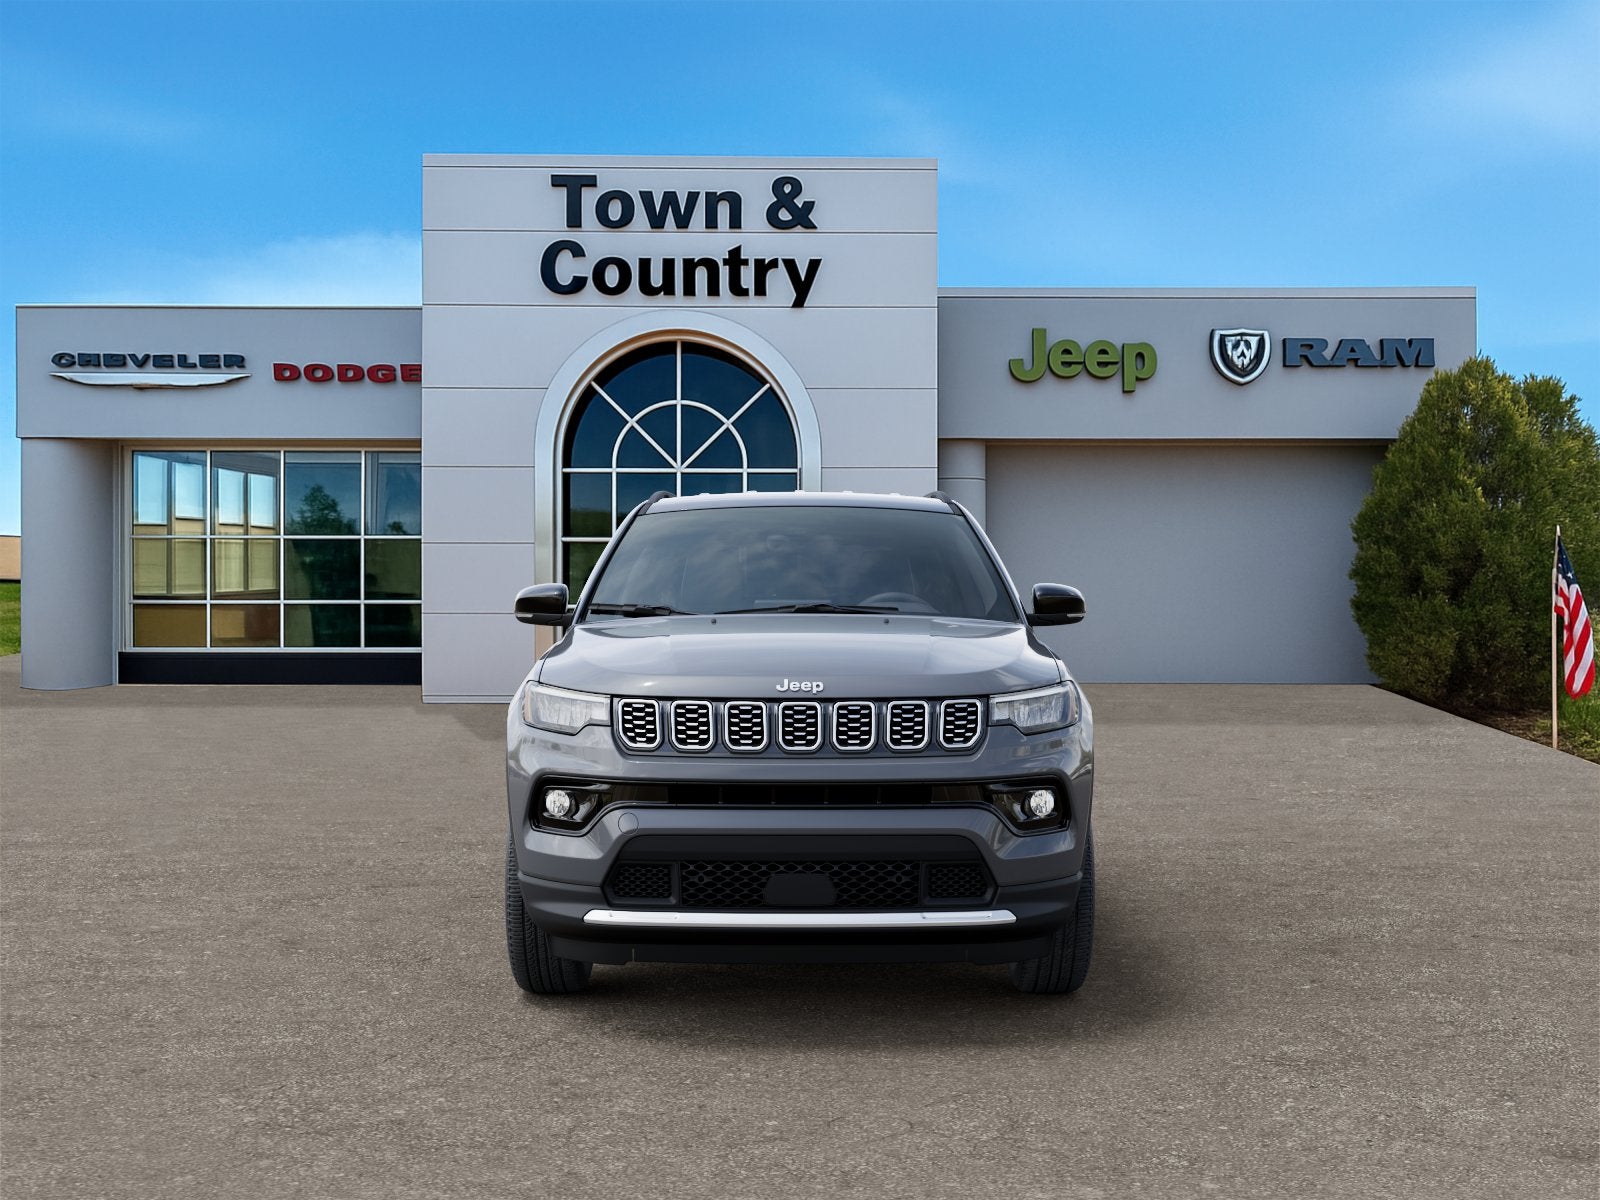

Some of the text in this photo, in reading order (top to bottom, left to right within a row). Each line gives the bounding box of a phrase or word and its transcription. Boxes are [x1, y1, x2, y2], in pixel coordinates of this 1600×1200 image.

[551, 174, 817, 229] Town &
[540, 239, 822, 308] Country
[273, 362, 422, 383] DODGE
[1009, 327, 1157, 393] Jeep
[1282, 337, 1435, 367] RAM
[776, 678, 824, 694] Jeep
